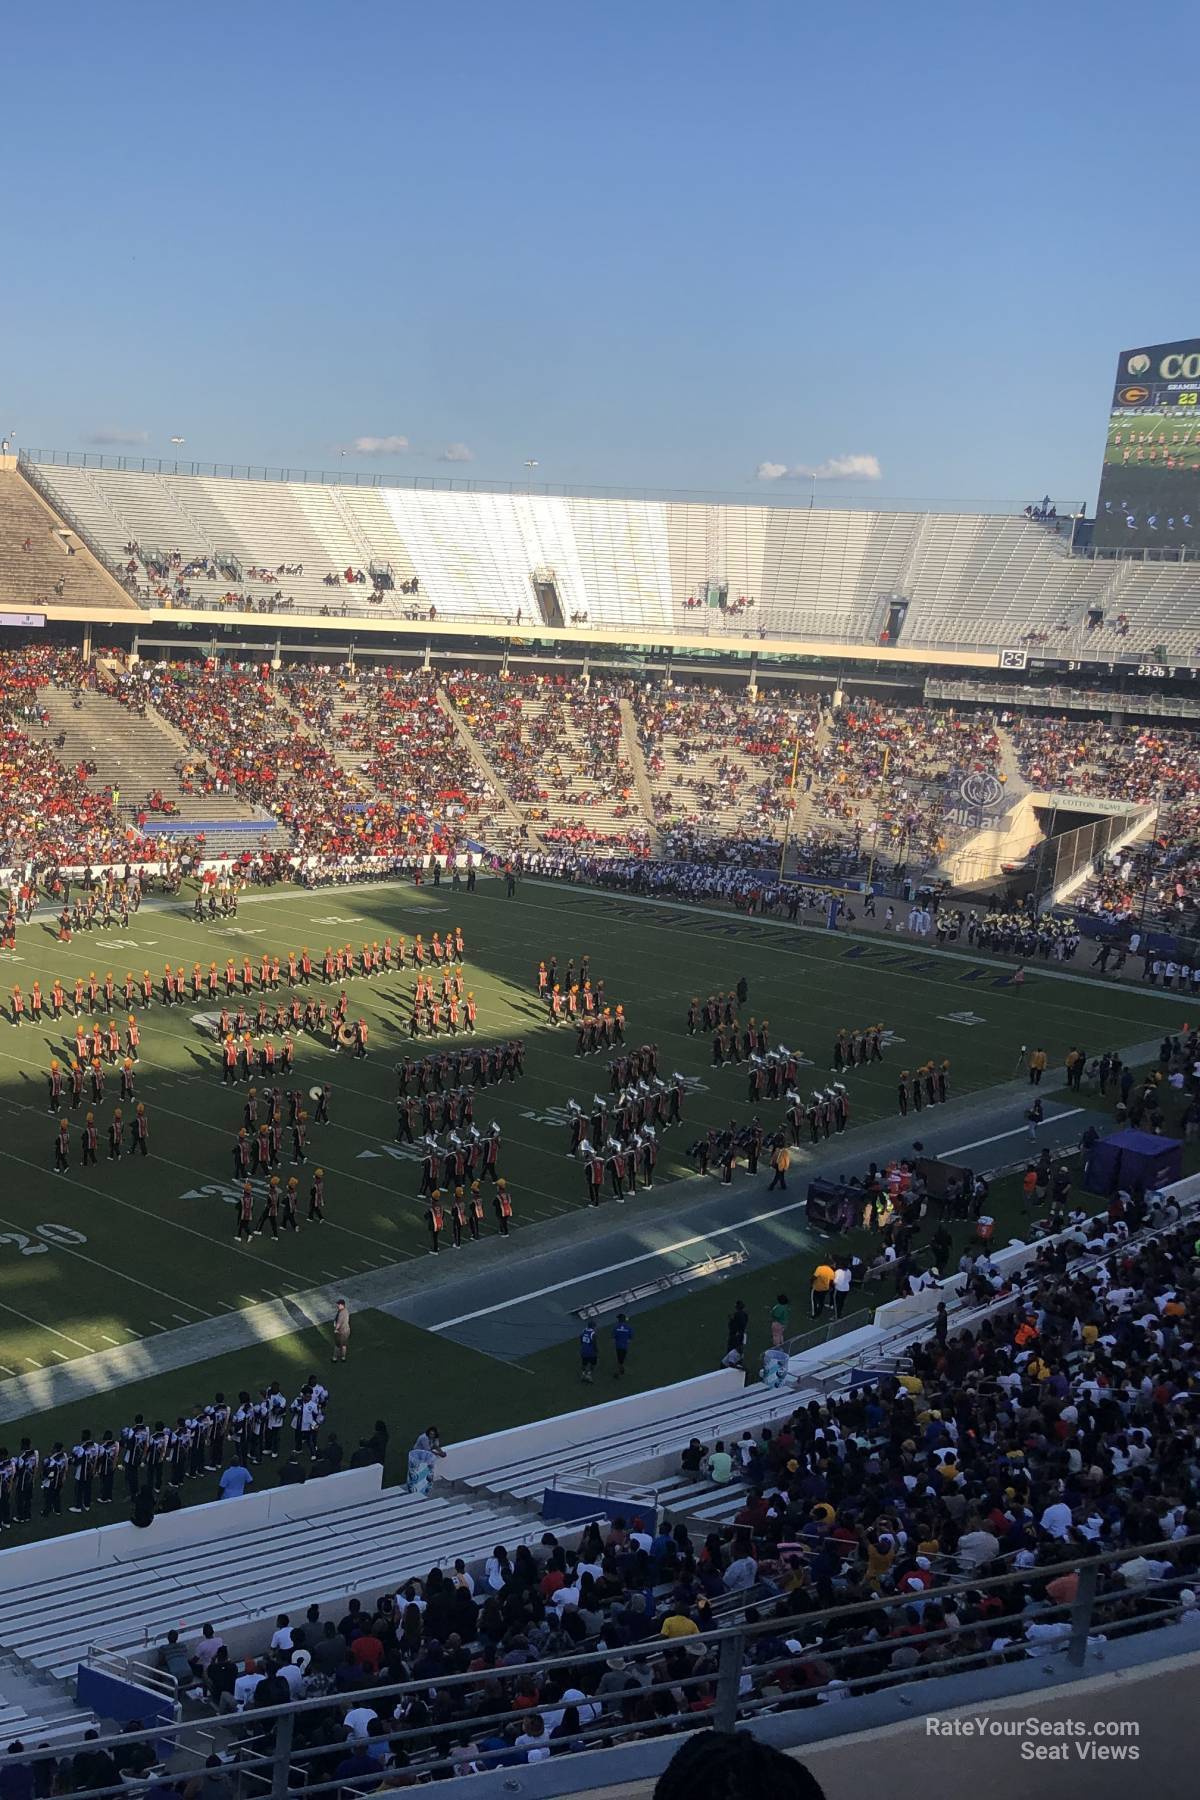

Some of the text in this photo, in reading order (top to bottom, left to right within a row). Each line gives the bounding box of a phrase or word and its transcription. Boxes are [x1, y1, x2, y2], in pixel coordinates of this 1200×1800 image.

[1178, 392, 1198, 404] 23
[1004, 652, 1023, 666] 25
[1068, 661, 1081, 671] 31
[1062, 799, 1096, 809] COTTON
[942, 808, 1001, 829] Allstat
